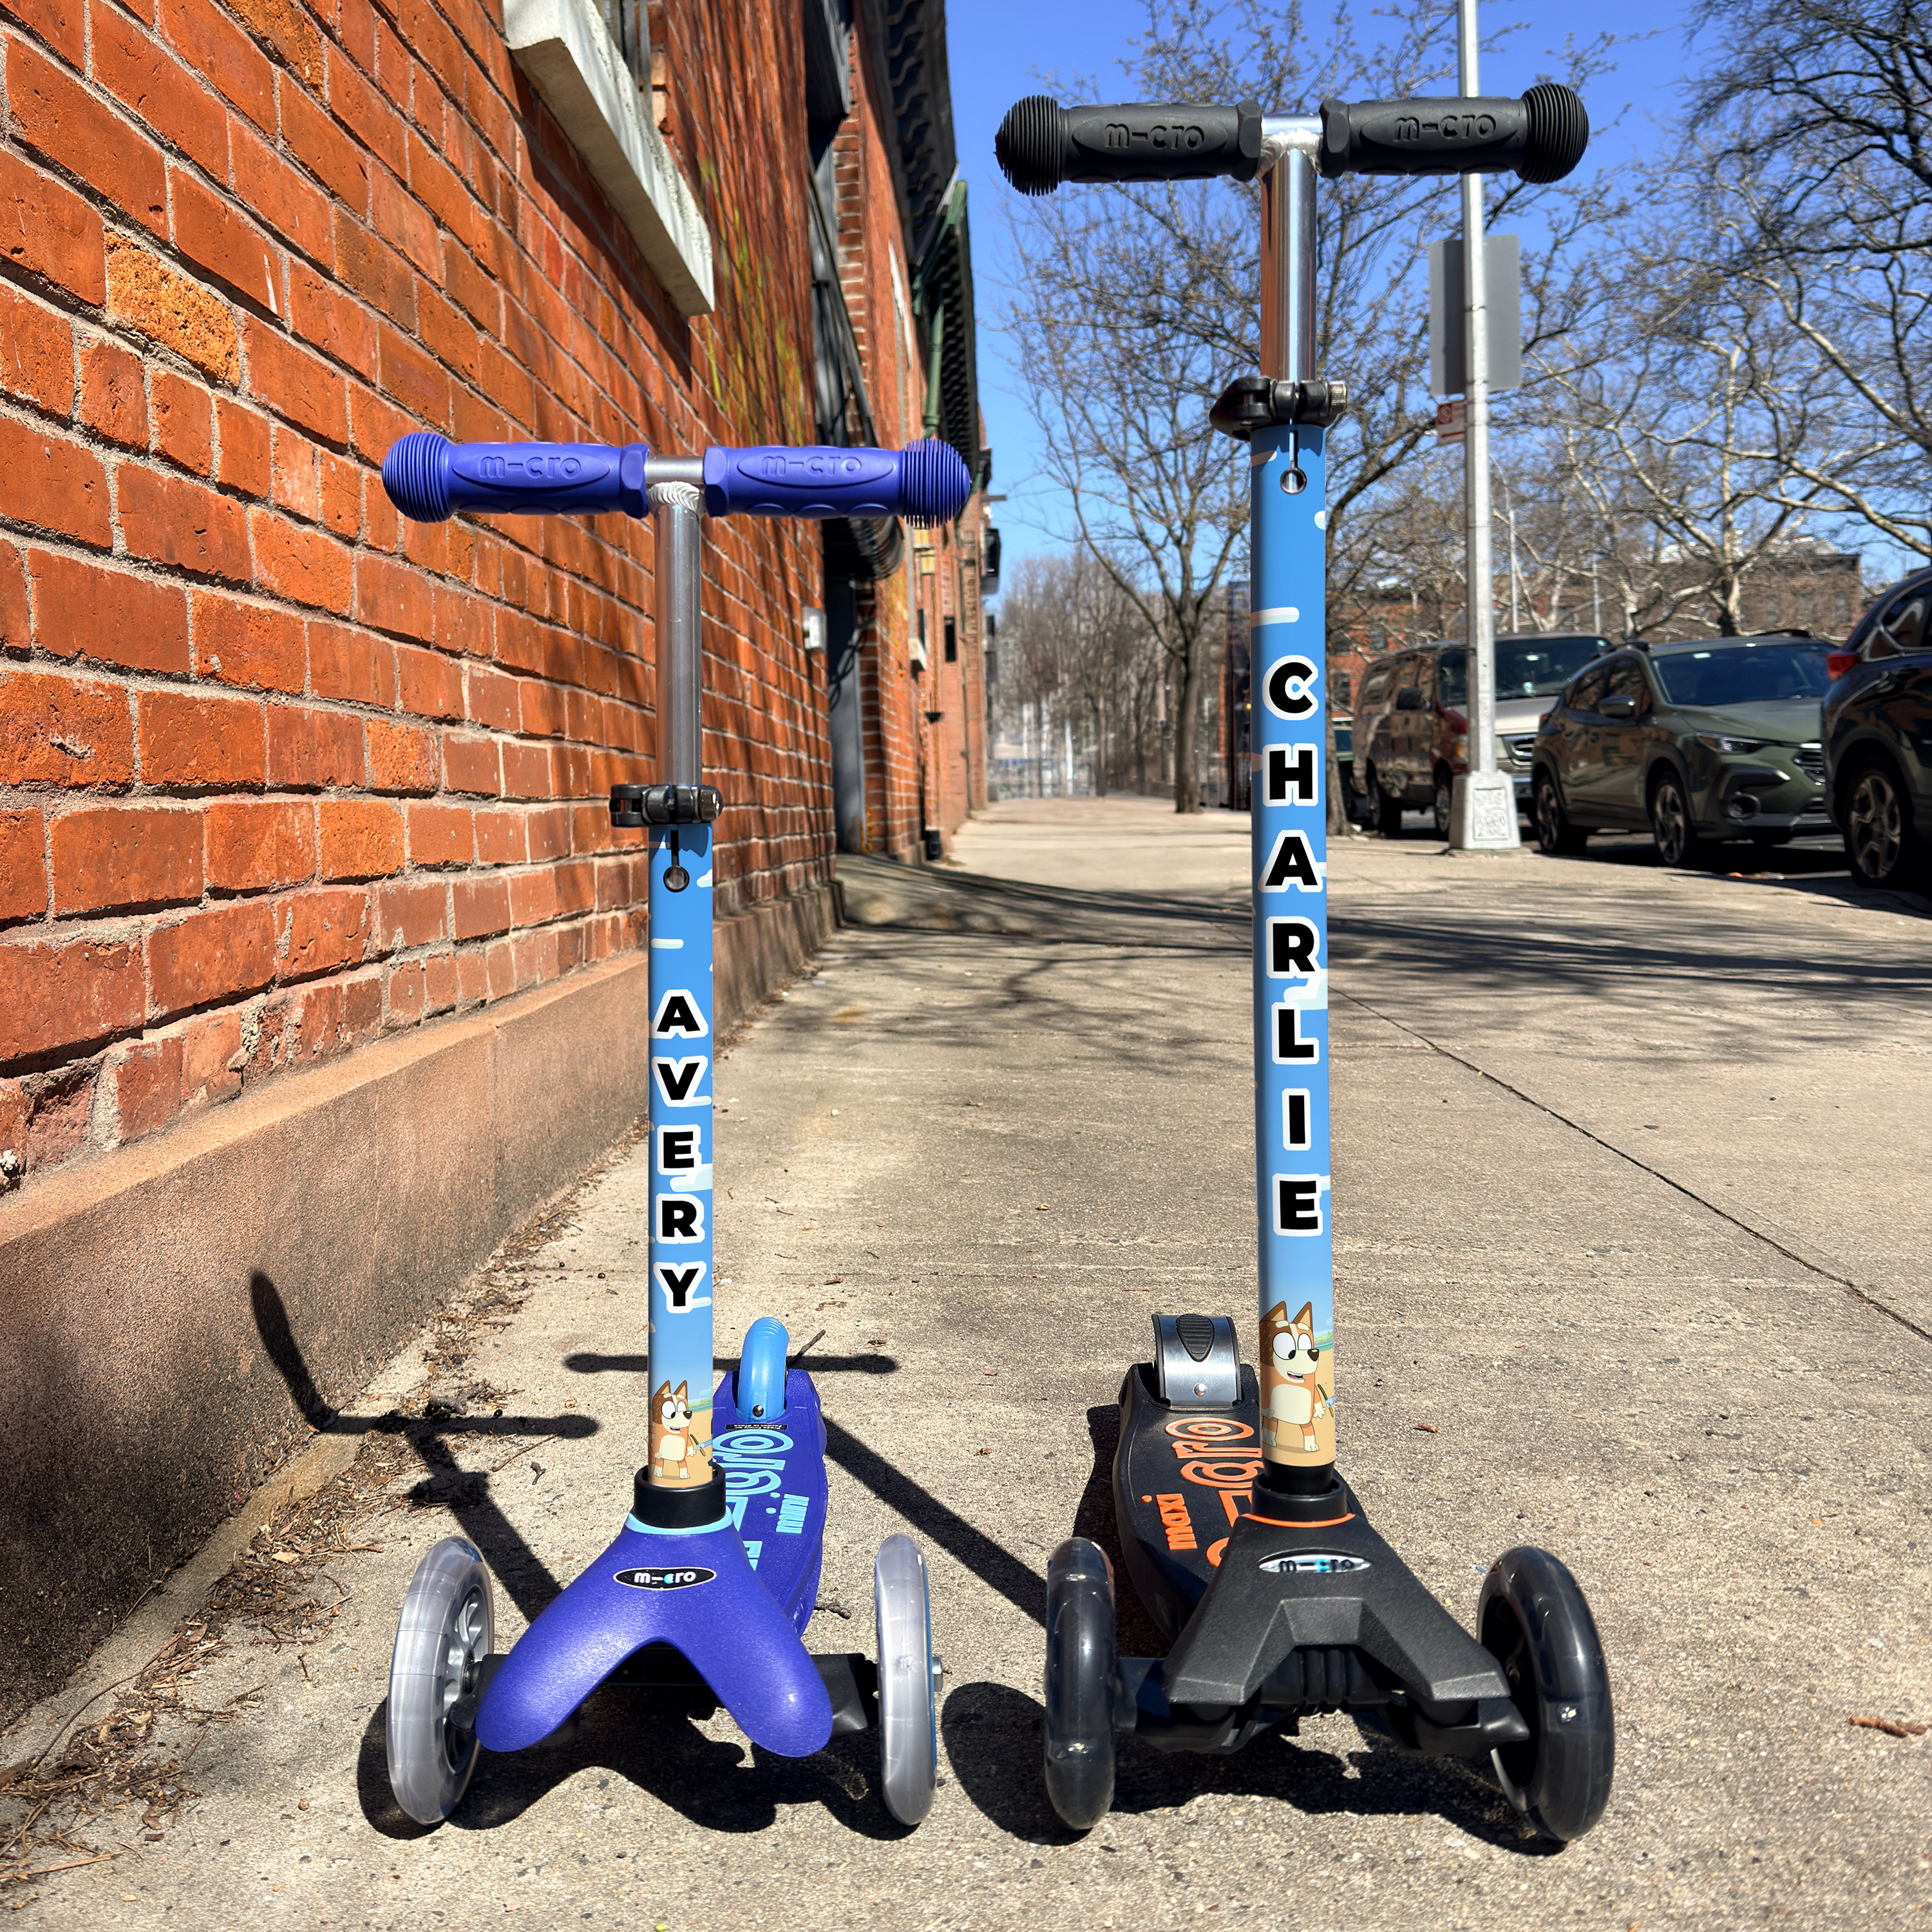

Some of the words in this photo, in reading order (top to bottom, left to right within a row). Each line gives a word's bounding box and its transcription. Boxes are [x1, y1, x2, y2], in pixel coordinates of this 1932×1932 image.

[1262, 659, 1321, 1233] CHARLIE
[654, 994, 703, 1309] AVERY
[766, 1492, 810, 1534] mini
[1141, 1493, 1198, 1551] maxi
